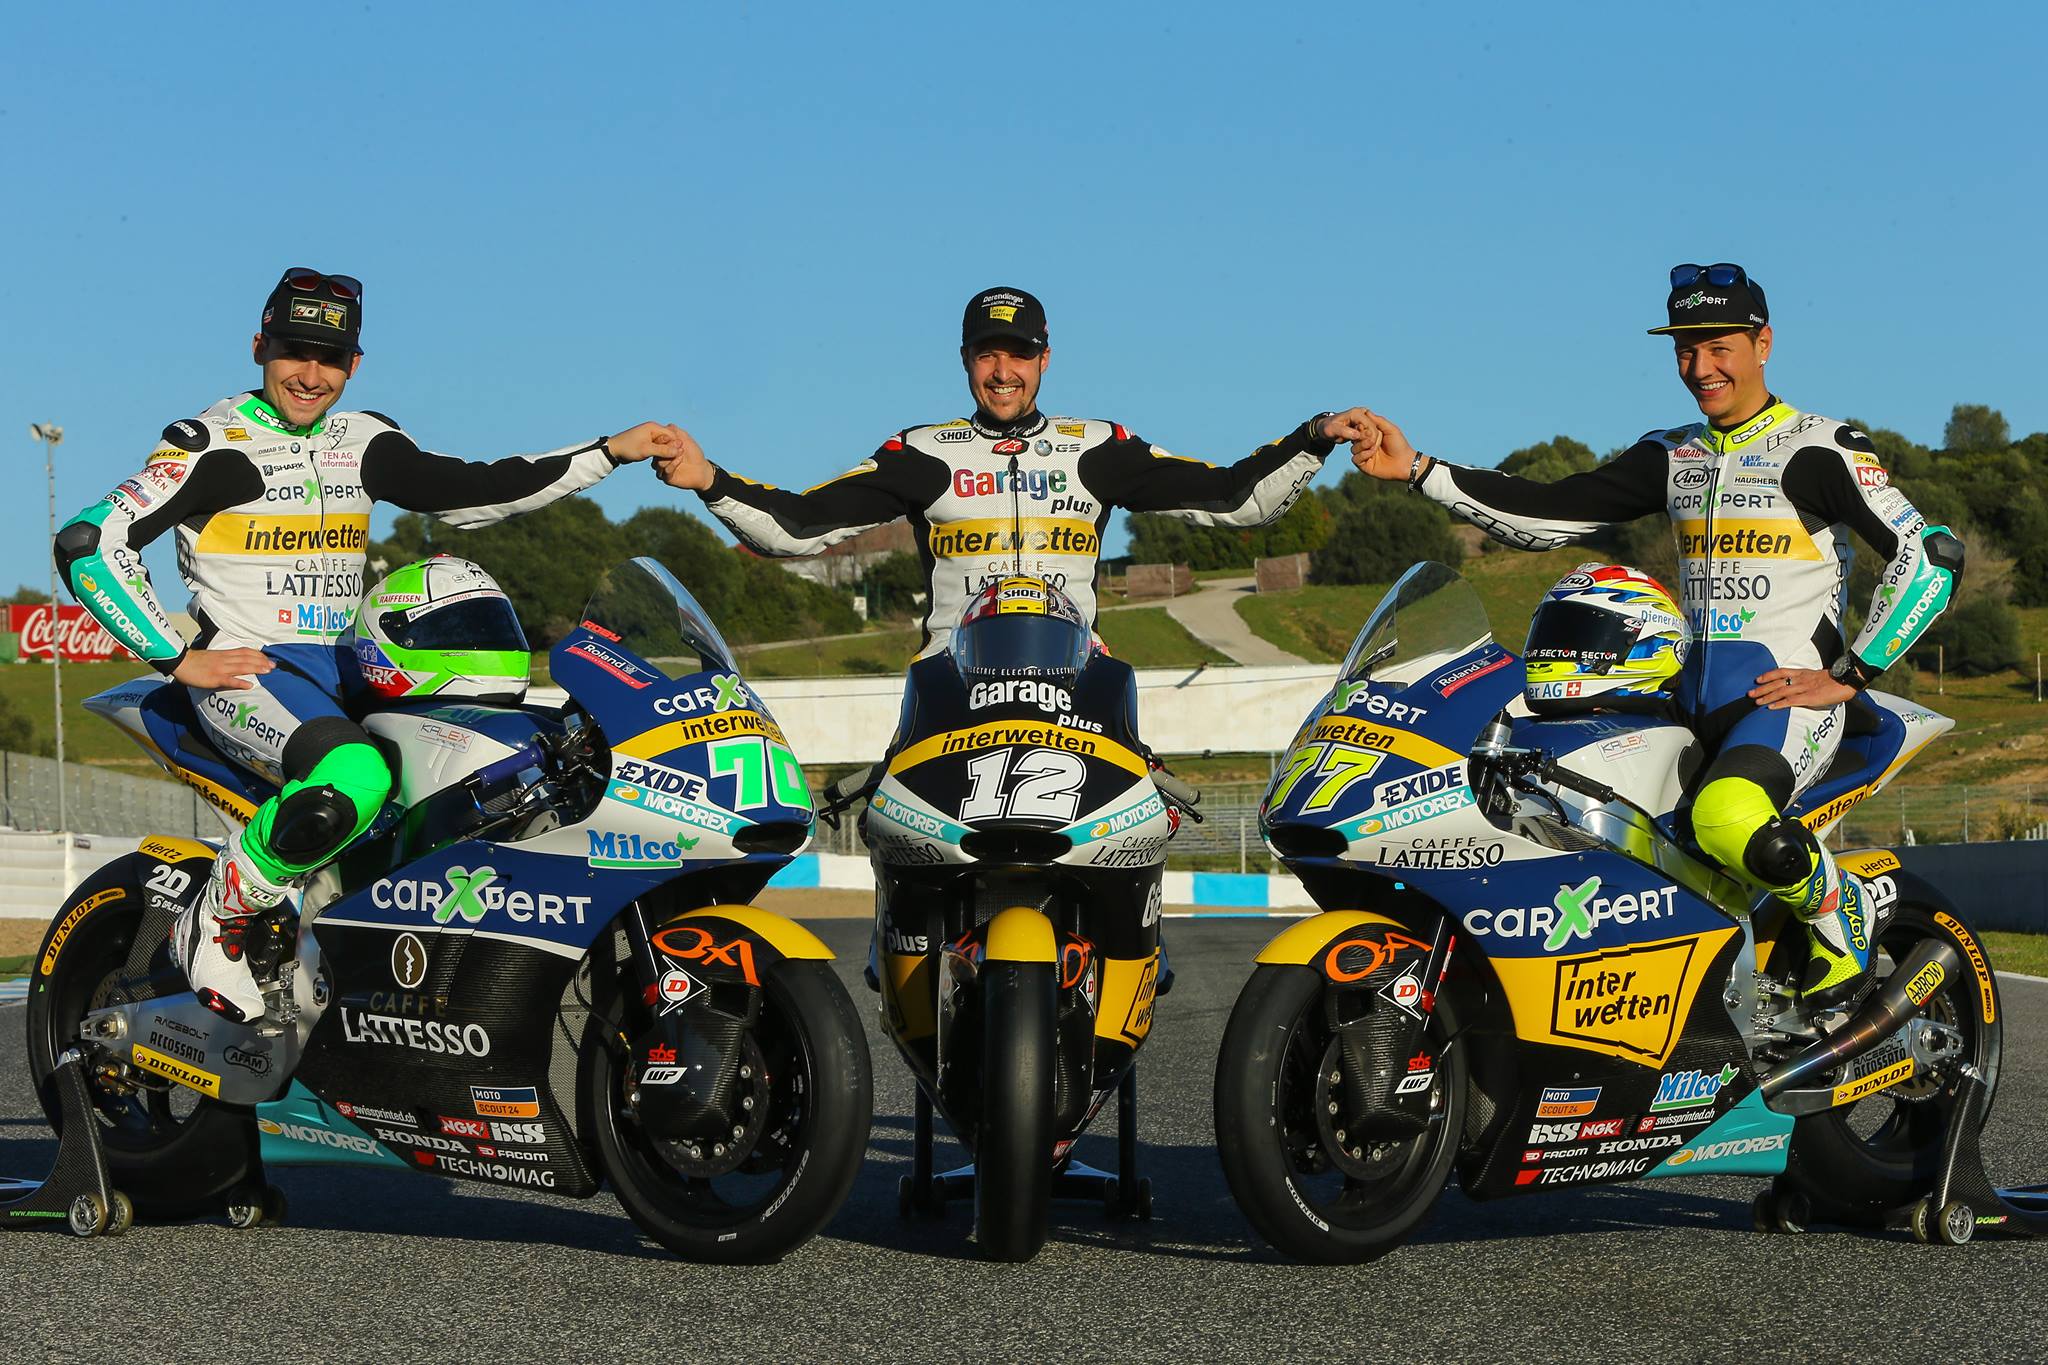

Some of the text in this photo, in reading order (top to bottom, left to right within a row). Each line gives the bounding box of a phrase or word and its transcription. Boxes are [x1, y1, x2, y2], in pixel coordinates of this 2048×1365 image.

[940, 430, 971, 441] SHOEI
[1055, 443, 1081, 453] GS
[320, 460, 359, 469] Informatik
[323, 452, 353, 460] TEN AG
[953, 469, 1067, 501] Garage
[1735, 477, 1779, 485] HAUSHERR
[104, 493, 138, 521] ONDA
[1050, 495, 1093, 515] plus
[245, 520, 366, 551] interwetten
[932, 526, 1097, 555] interwetten
[988, 561, 1043, 573] CAFFE
[265, 572, 361, 598] LATTESSO
[1004, 589, 1041, 598] SHOEI
[1682, 575, 1771, 600] ATTESSO
[379, 594, 421, 604] RAIFFEISEN
[1896, 572, 1948, 640] MOTOREX
[93, 589, 152, 651] MOTOREX
[297, 603, 348, 630] Milco
[1641, 610, 1671, 624] Diener
[584, 643, 626, 669] Roland
[1540, 649, 1617, 661] SECTOR SECTOR
[1439, 663, 1480, 687] Roland
[969, 679, 1072, 713] Garage
[1542, 682, 1562, 698] AG
[1057, 713, 1103, 734] plus
[941, 728, 1096, 754] interwetten
[616, 761, 703, 802] EXIDE
[706, 735, 813, 812] 70
[958, 744, 1087, 823] 12
[1268, 741, 1389, 817] 77
[1381, 766, 1464, 808] EXIDE
[644, 792, 732, 835] MOTOREX
[883, 799, 946, 838] MOTOREX
[1109, 795, 1165, 833] MOTOREX
[1383, 789, 1471, 830] MOTOREX
[143, 841, 184, 861] Hertz
[586, 829, 682, 860] Milco
[1377, 842, 1505, 869] LATTESSO
[1412, 837, 1477, 849] CAFFE
[1860, 856, 1896, 875] Hertz
[48, 898, 95, 963] DUNLOP
[1944, 918, 1989, 984] DUNLOP
[1565, 965, 1637, 1001] inter
[1910, 962, 1944, 1004] ARROW
[1574, 993, 1671, 1028] wetten
[154, 1015, 210, 1041] RACEBOLT
[340, 1006, 490, 1058] LATTESSO
[150, 1031, 206, 1065] ACCOSSATO
[230, 1053, 264, 1069] AFAM
[148, 1057, 214, 1089] DUNLOP
[1655, 1069, 1724, 1103] Milco
[1851, 1063, 1911, 1097] DUNLOP
[475, 1091, 500, 1100] MOTO
[479, 1103, 519, 1115] SCOUT 24
[1545, 1091, 1571, 1101] MOTO
[1541, 1106, 1578, 1115] SCOUT 24
[280, 1122, 385, 1157] MOTOREX
[374, 1127, 472, 1154] HONDA
[441, 1119, 478, 1137] NGK
[1580, 1121, 1617, 1138] NGK
[1596, 1134, 1683, 1155] HONDA
[1690, 1133, 1791, 1163] MOTOREX
[436, 1154, 556, 1188] TECHNOMAG
[1539, 1157, 1650, 1185] TECHNOMAG
